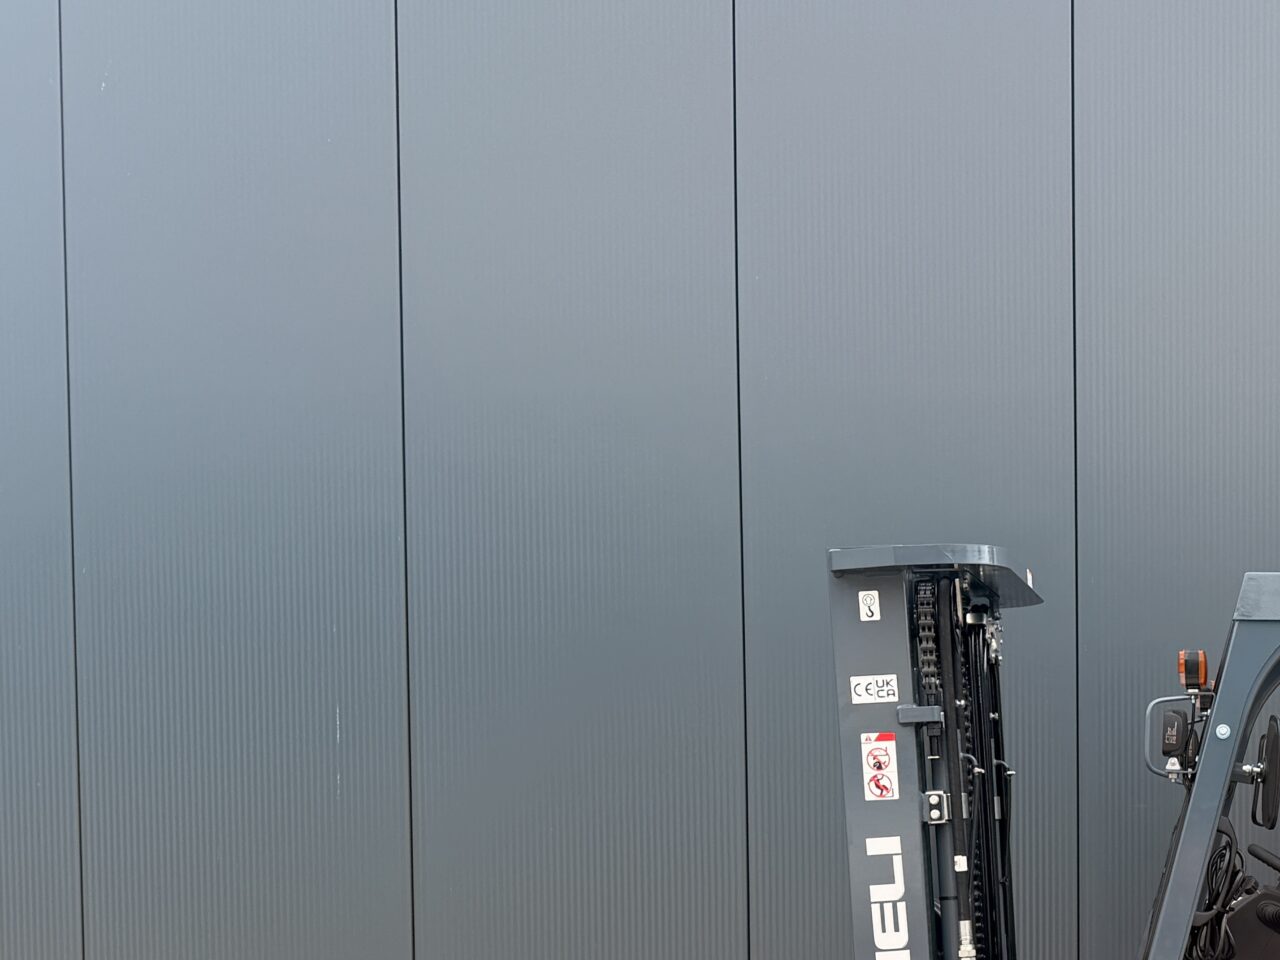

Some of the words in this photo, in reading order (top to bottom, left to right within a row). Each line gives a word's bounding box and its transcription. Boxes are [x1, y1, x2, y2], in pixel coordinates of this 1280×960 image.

[854, 683, 873, 697] CE
[876, 679, 894, 687] UK
[877, 689, 896, 698] CA
